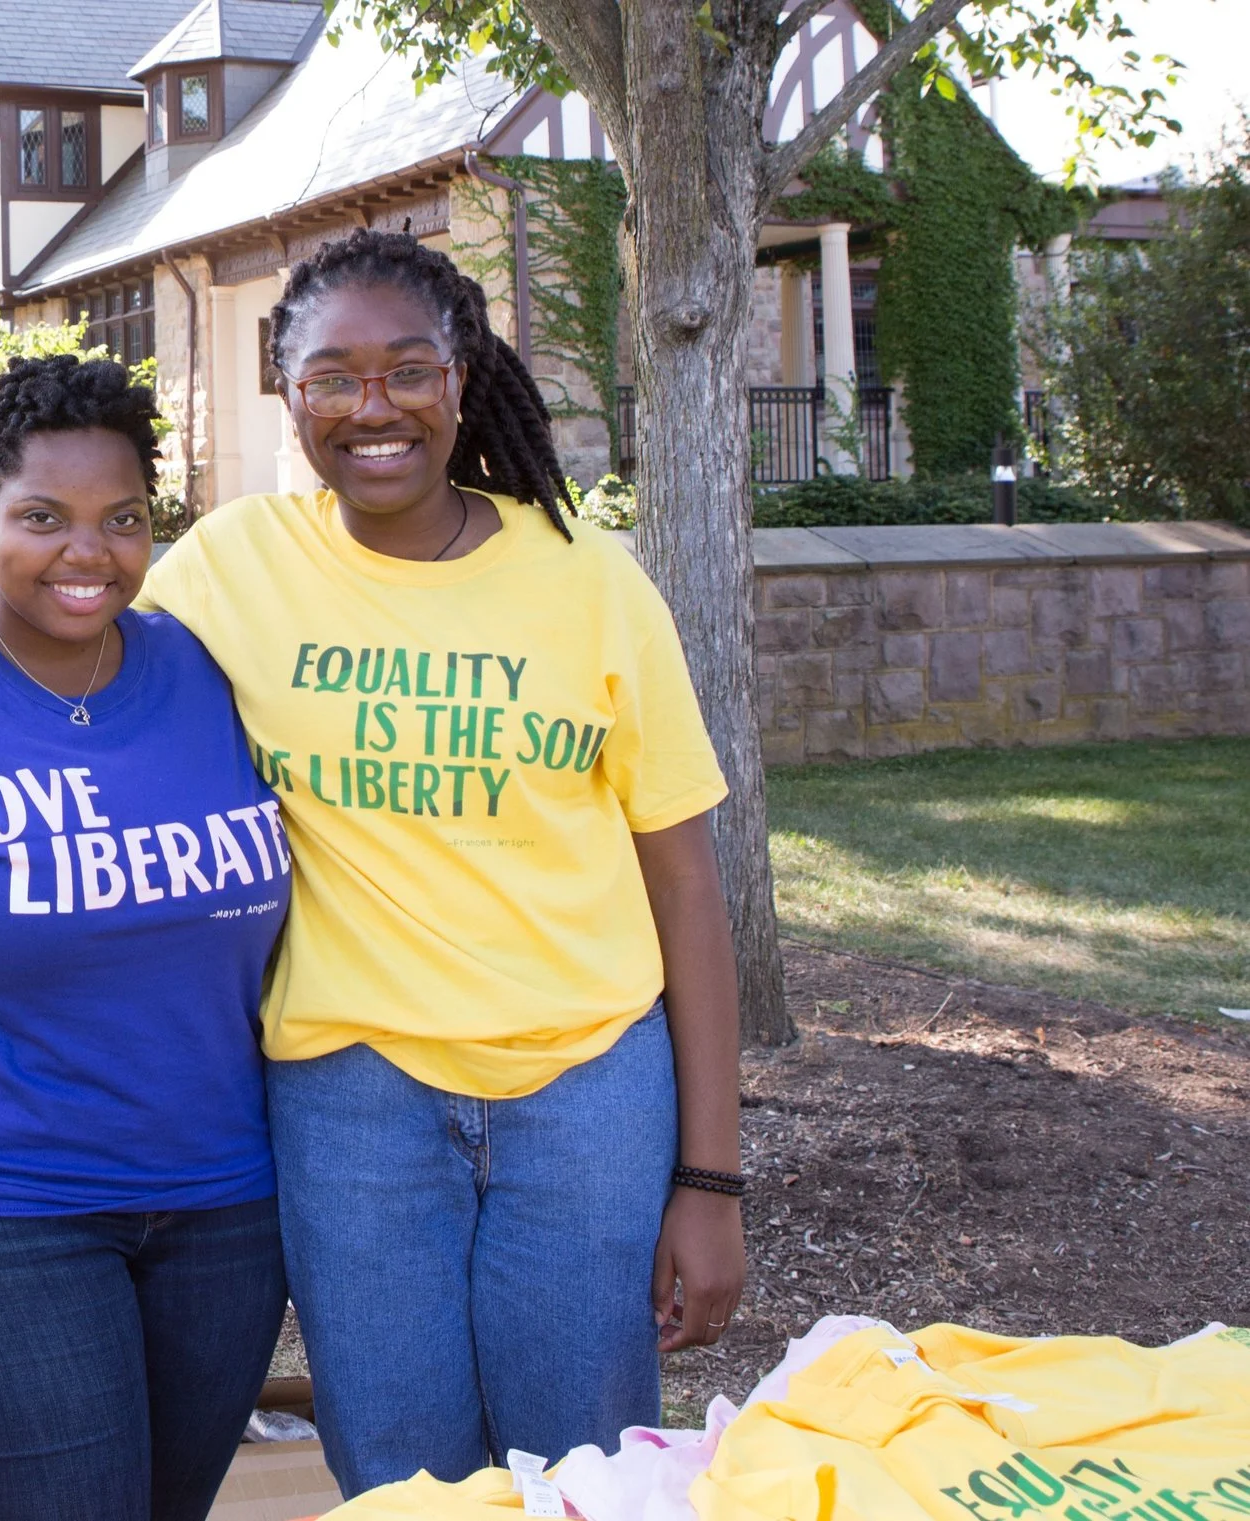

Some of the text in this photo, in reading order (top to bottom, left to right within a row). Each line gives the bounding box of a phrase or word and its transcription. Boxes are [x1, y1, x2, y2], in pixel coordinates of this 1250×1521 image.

[291, 642, 527, 701] EQUALITY
[355, 700, 398, 753] IS
[415, 703, 506, 760] THE
[309, 753, 511, 818] LIBERTY
[7, 799, 291, 915] LIBERATE
[246, 900, 279, 915] Angelou
